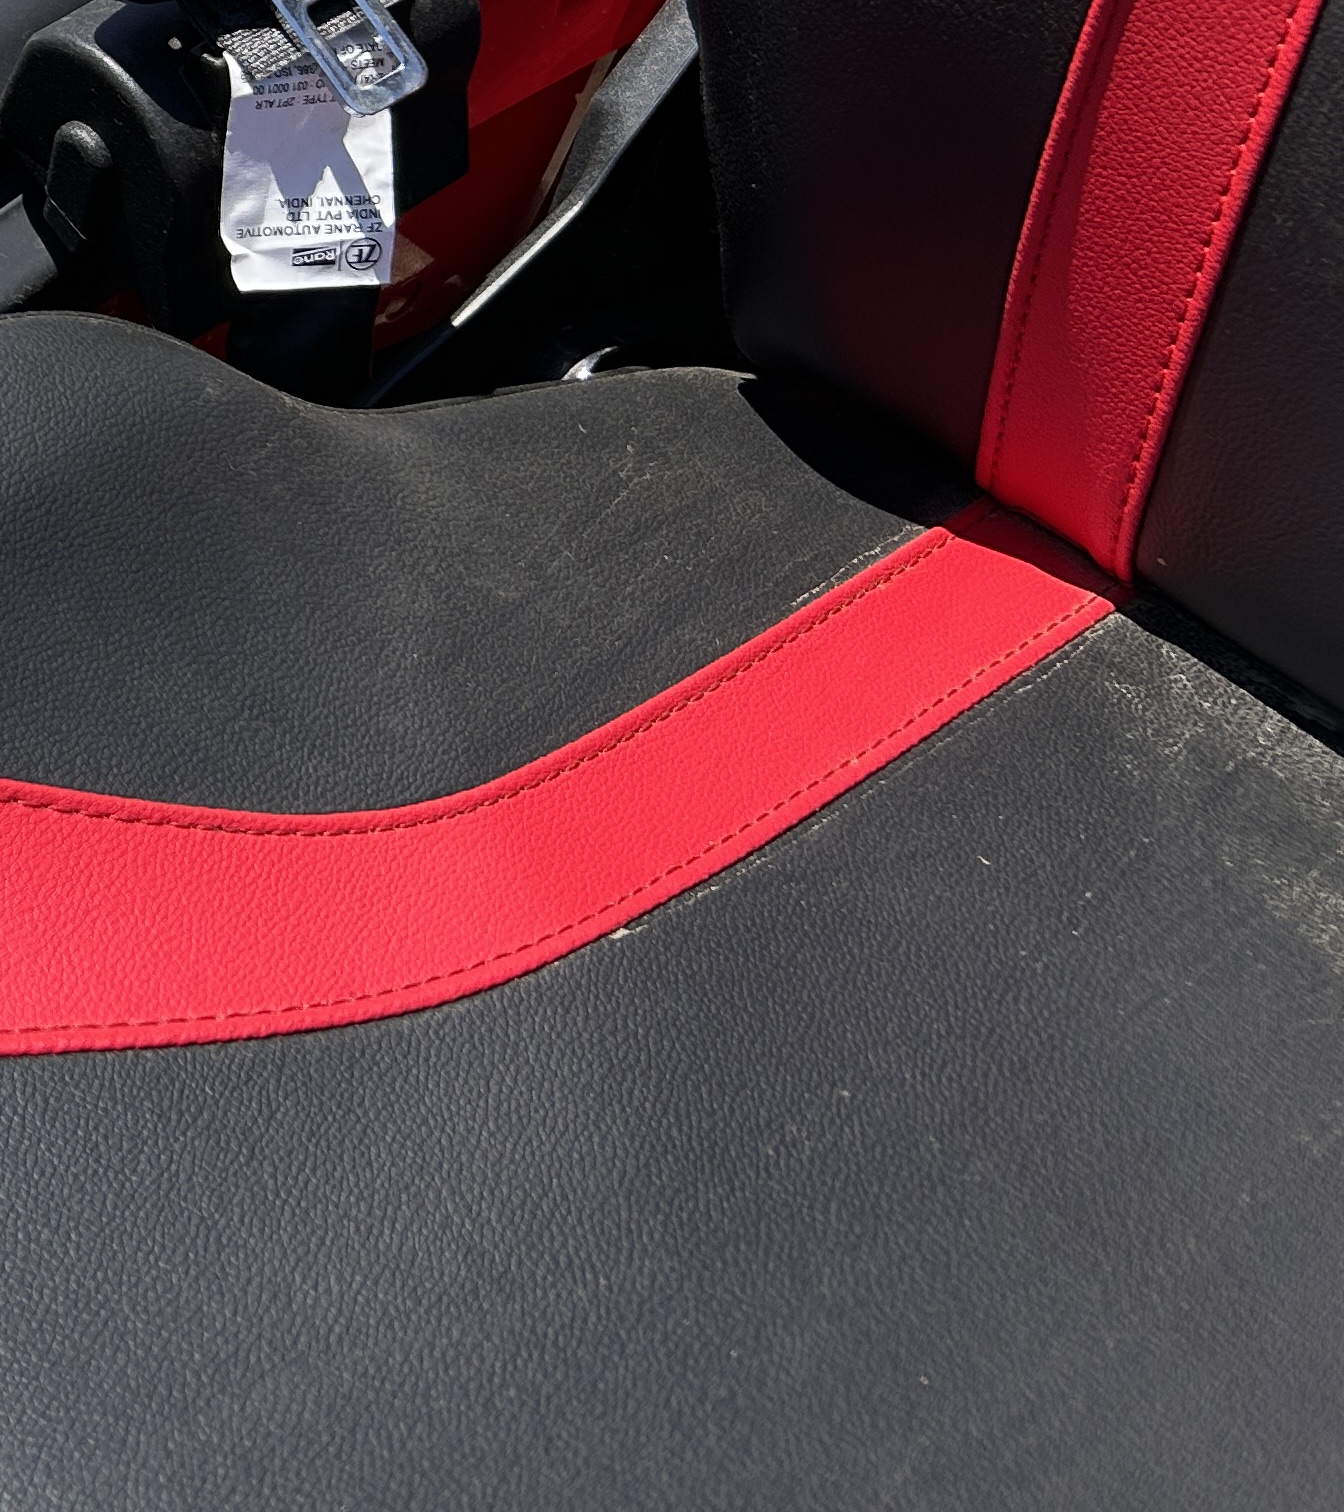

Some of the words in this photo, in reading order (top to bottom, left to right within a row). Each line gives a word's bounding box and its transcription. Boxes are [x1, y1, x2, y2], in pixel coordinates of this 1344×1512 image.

[314, 208, 342, 221] PVT
[345, 206, 380, 220] INDIA
[234, 222, 321, 239] AUTOMOTIVE
[323, 221, 362, 235] RANE
[365, 221, 382, 233] ZF
[291, 248, 336, 265] Rane
